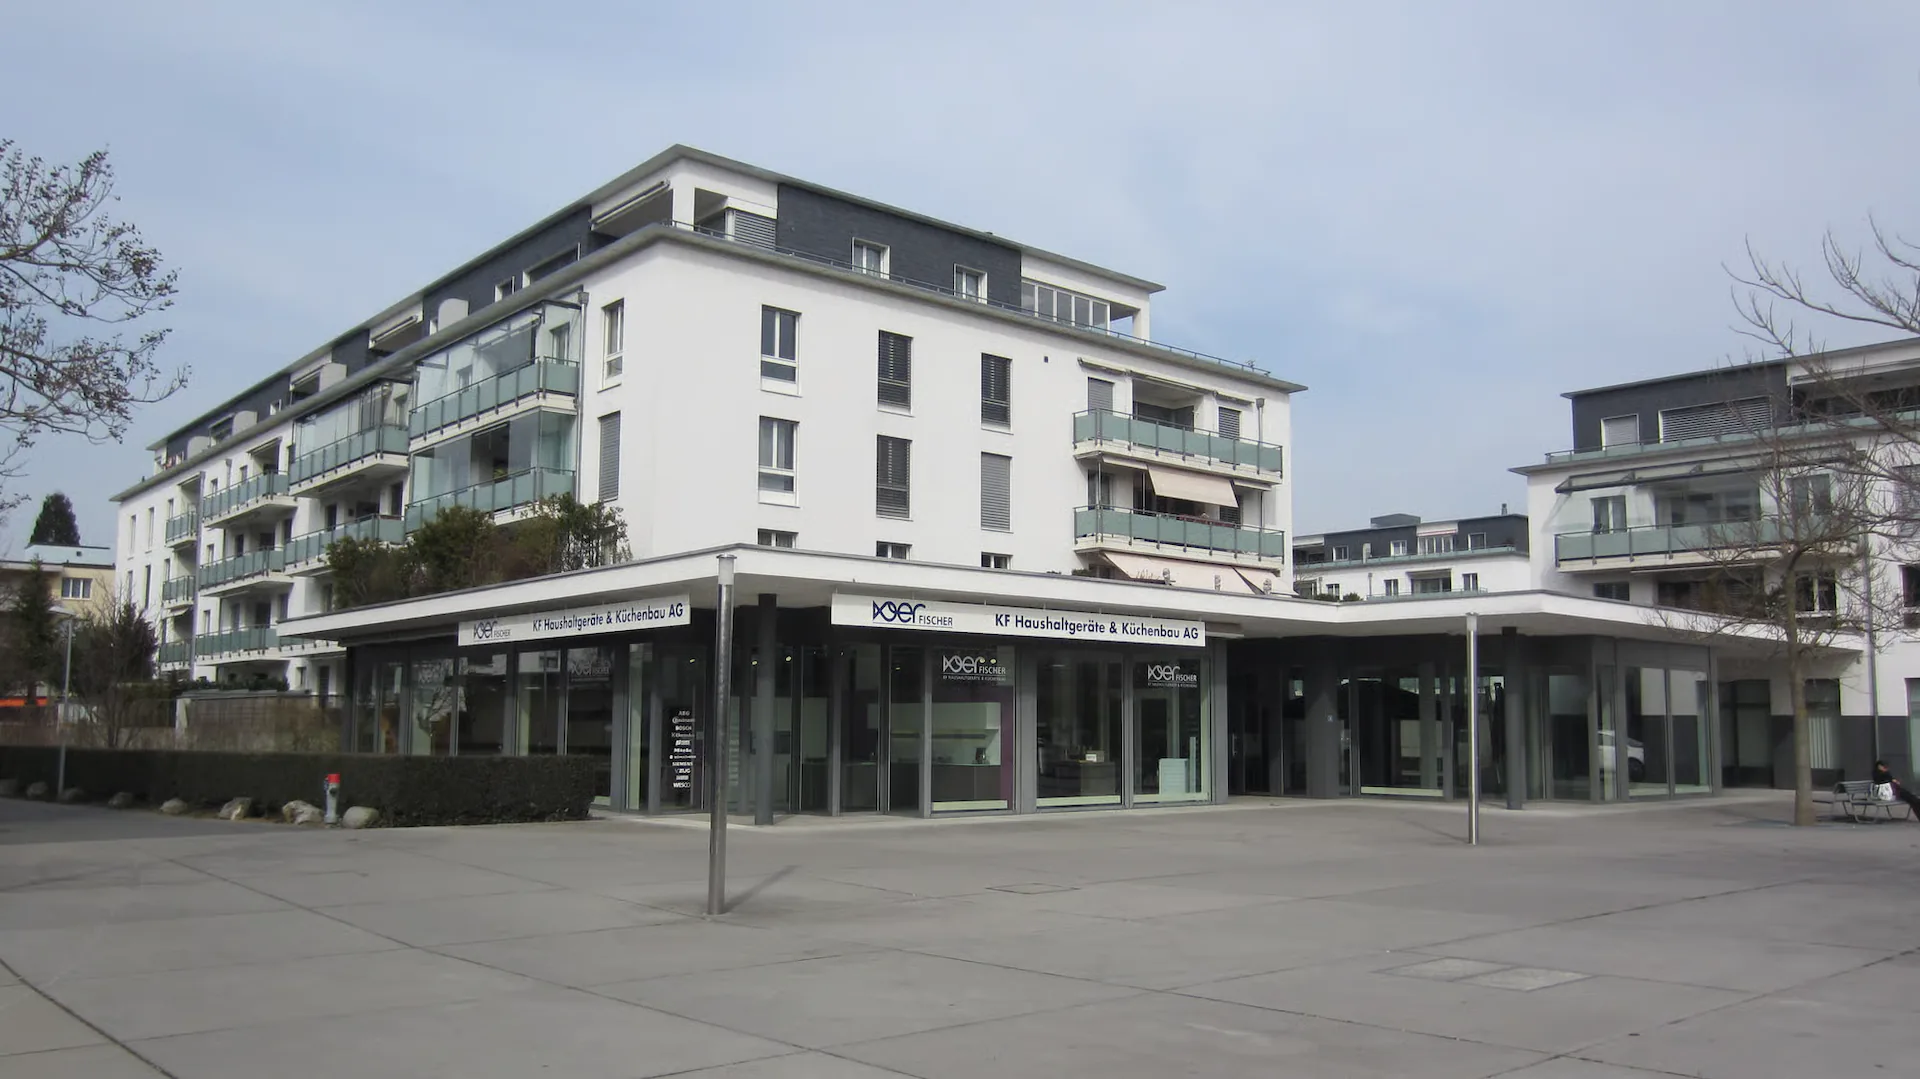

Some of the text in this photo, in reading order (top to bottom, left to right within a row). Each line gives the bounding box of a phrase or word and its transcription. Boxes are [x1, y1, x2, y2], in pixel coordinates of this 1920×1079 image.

[532, 602, 684, 632] KF Haushaltgeräte & Küchenbau AG
[918, 615, 953, 627] FISCHER
[995, 614, 1199, 640] KF Haushaltgeräte & Küchenbau AG
[979, 666, 1006, 674] FISCHER
[1175, 674, 1197, 682] FISCHER
